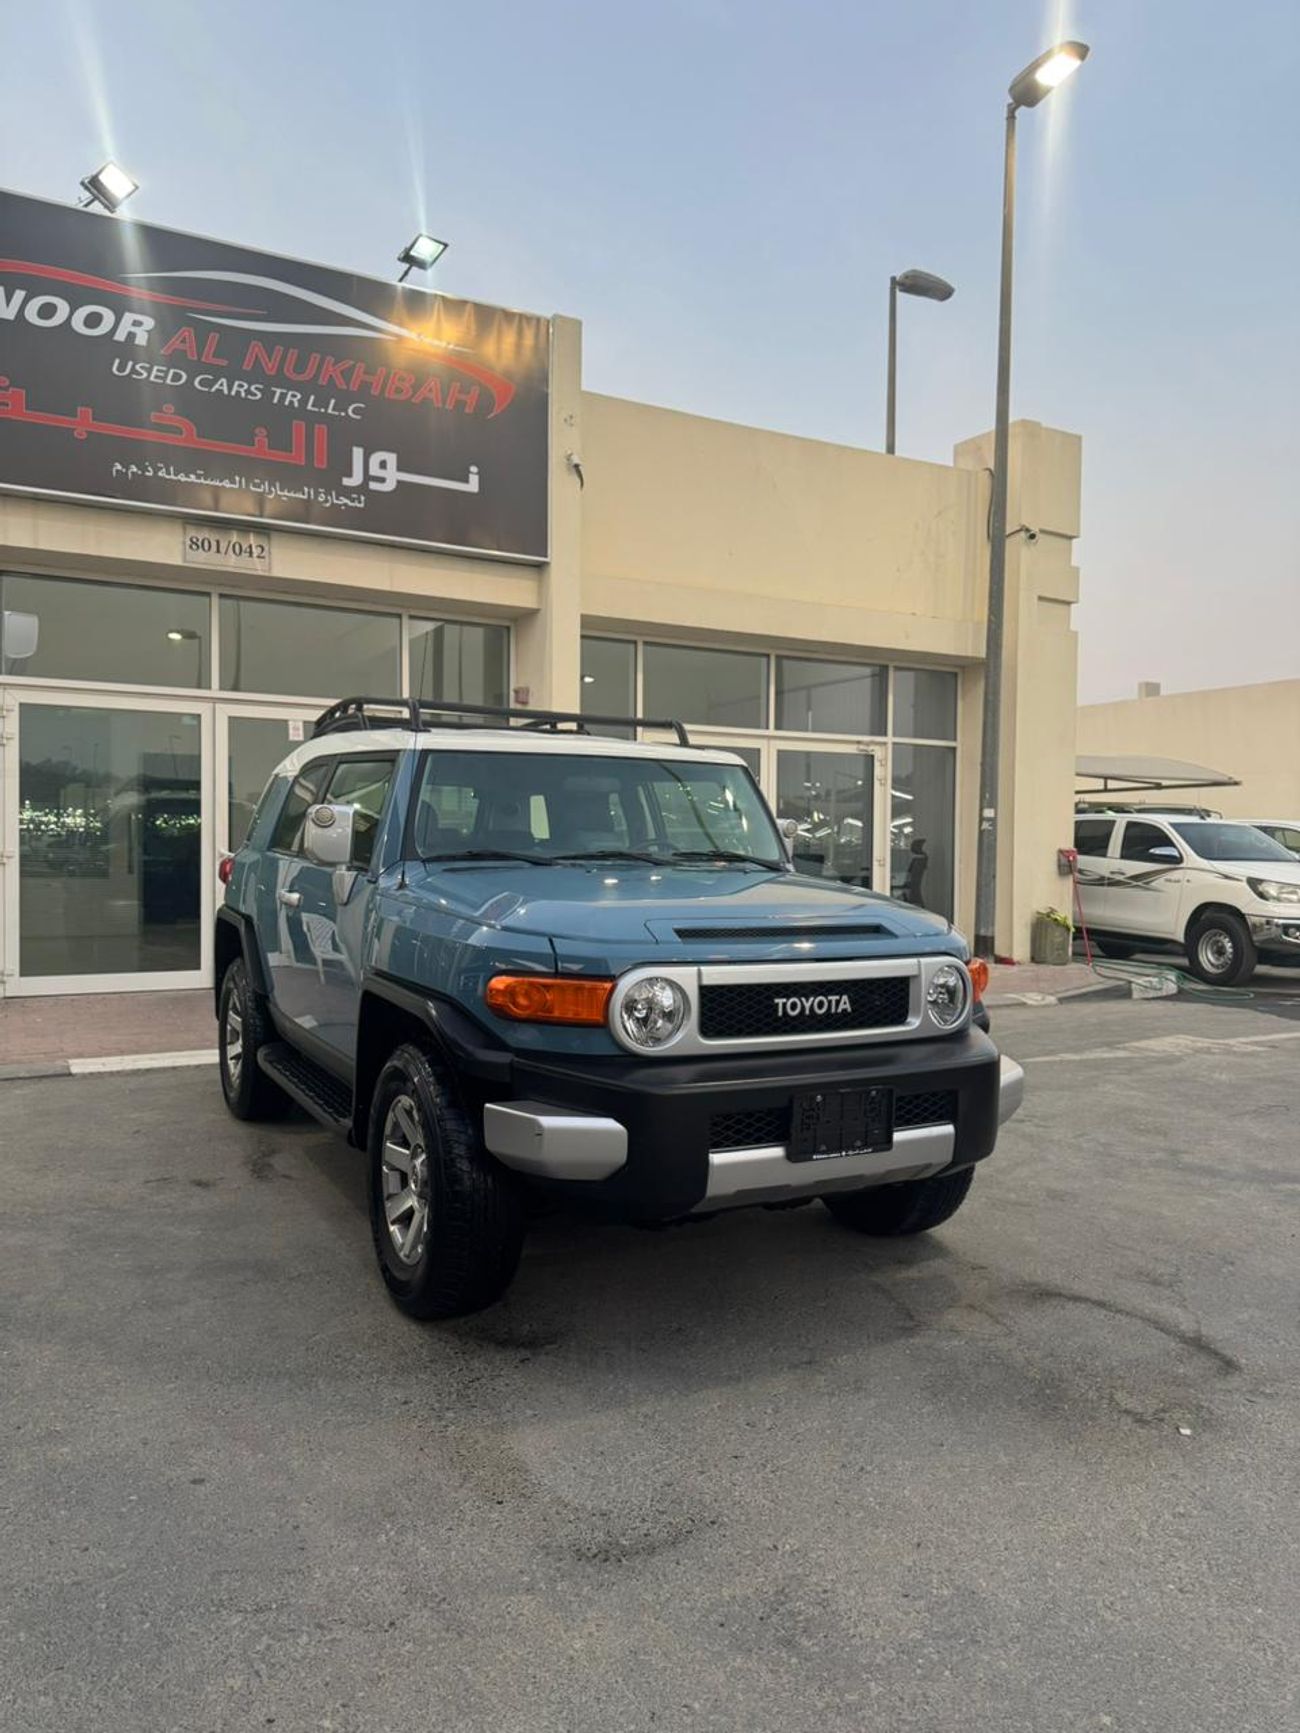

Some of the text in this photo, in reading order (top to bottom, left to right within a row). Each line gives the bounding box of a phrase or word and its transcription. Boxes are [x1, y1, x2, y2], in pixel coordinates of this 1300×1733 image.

[160, 326, 229, 367] AL
[242, 341, 479, 413] NUKHBAH
[111, 357, 366, 419] USED CARS TR L.L.C
[158, 465, 246, 489] المستعملة
[341, 446, 480, 493] نور
[250, 477, 315, 500] السيارات
[317, 487, 366, 509] لتجارة
[188, 535, 266, 560] 801/042
[774, 995, 852, 1017] TOYOTA
